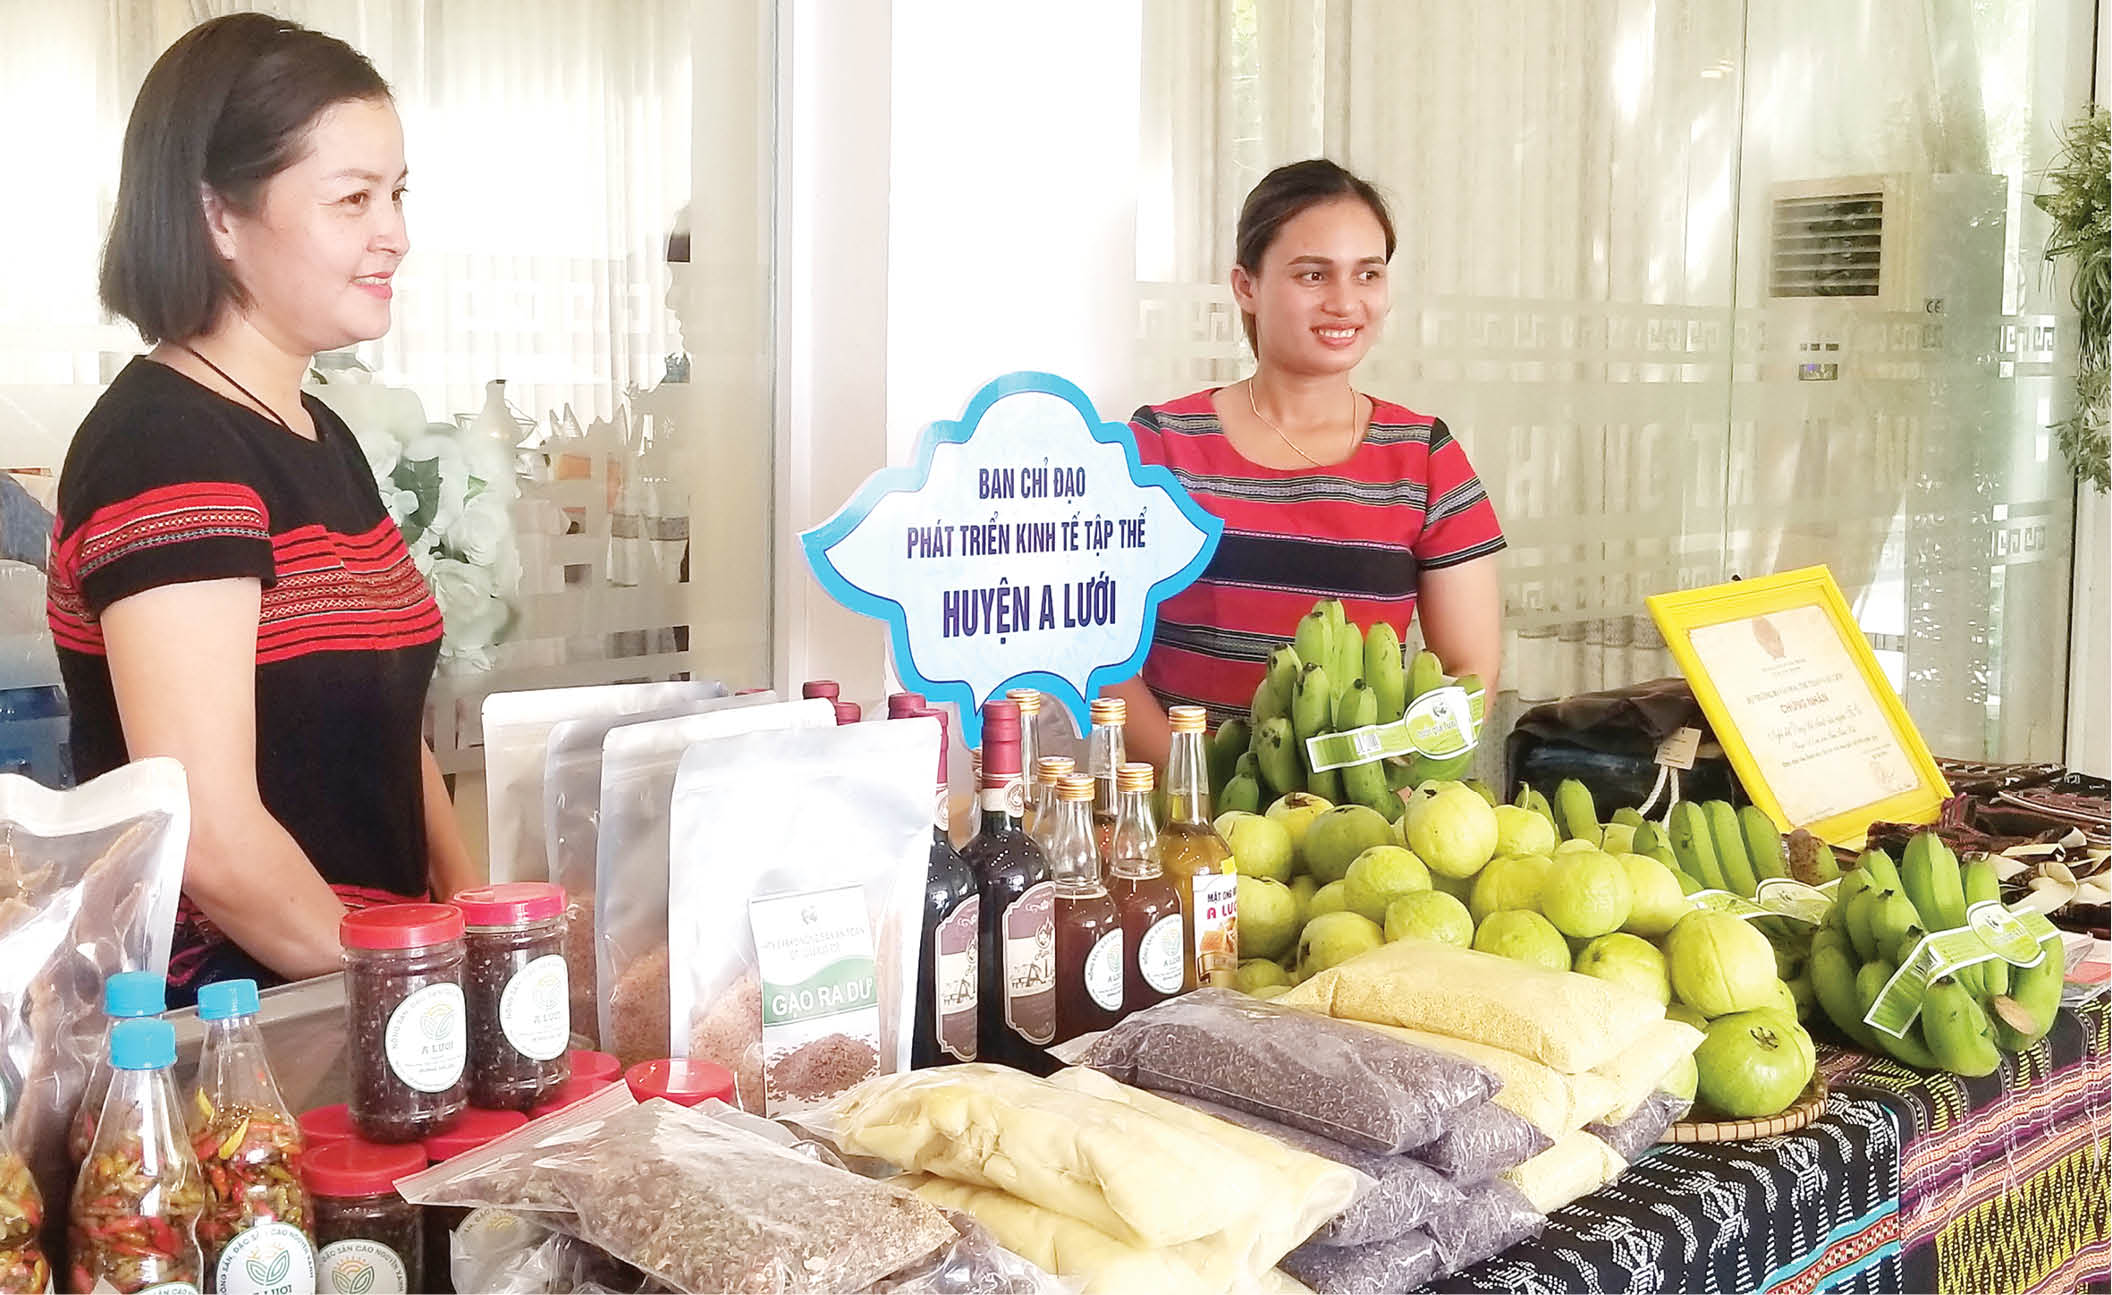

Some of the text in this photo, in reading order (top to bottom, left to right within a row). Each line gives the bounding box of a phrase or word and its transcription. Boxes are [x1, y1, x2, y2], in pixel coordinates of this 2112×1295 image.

[979, 456, 1086, 504] BAN CHỈ ĐẠO
[907, 506, 1148, 559] PHÁT TRIỂN KINH TẾ TẬP THỂ
[943, 571, 1116, 645] HUYỆN A LƯỚI
[1206, 906, 1217, 920] A
[772, 988, 814, 1019] GẠO
[818, 985, 842, 1008] RA
